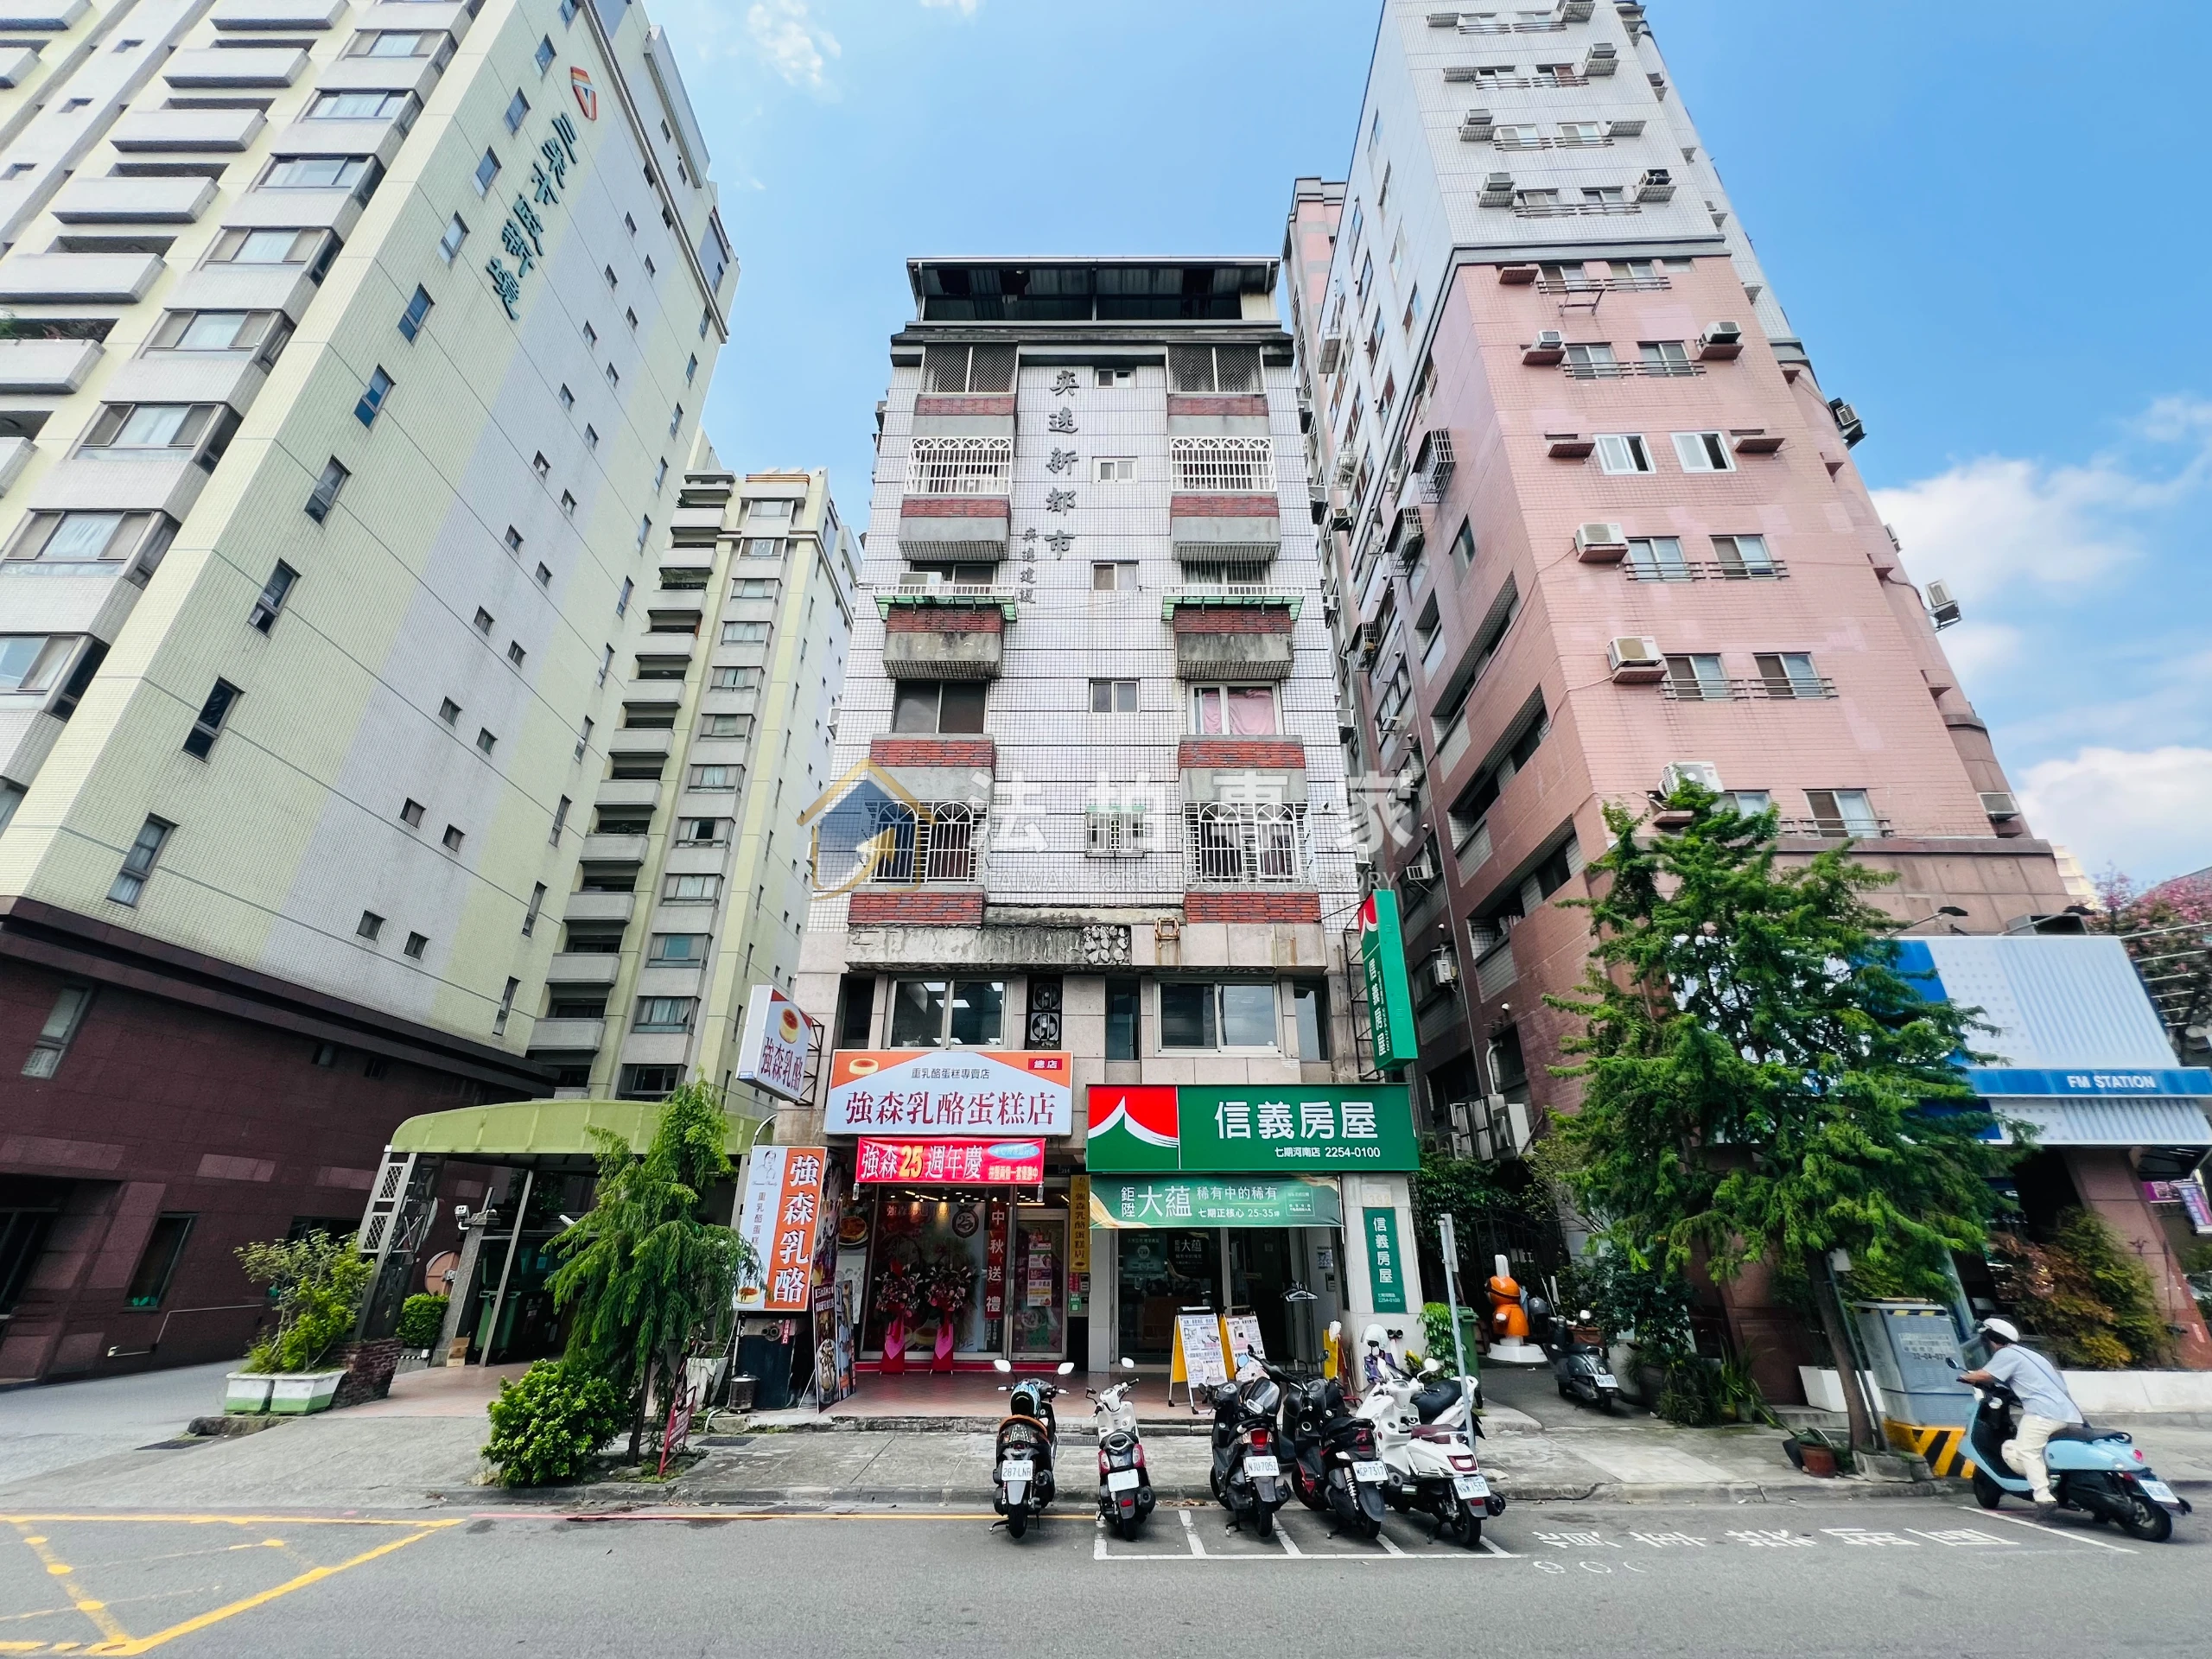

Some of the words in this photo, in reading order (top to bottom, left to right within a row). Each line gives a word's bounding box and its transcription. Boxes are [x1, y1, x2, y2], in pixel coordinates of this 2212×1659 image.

[485, 111, 578, 321] 三采市政新境
[760, 1036, 804, 1093] 強森乳酪
[912, 1068, 990, 1079] 重乳酪蛋糕專賣店
[1033, 1059, 1058, 1069] 總店
[2067, 1075, 2090, 1088] FM
[2094, 1075, 2157, 1088] STATION
[846, 1091, 1056, 1125] 強森乳酪蛋糕店
[1214, 1101, 1378, 1140] 信義房屋
[861, 1145, 983, 1179] 強森25週年慶
[1274, 1147, 1321, 1158] 七期河南店
[1325, 1147, 1381, 1158] 2254-0100
[1196, 1185, 1278, 1201] 稀有中的稀有
[1370, 1194, 1391, 1205] 392
[773, 1154, 821, 1304] 強森乳酪
[1198, 1207, 1244, 1218] 七期正核心
[986, 1209, 1005, 1313] 中秋送禮
[1373, 1217, 1393, 1283] 信義房屋
